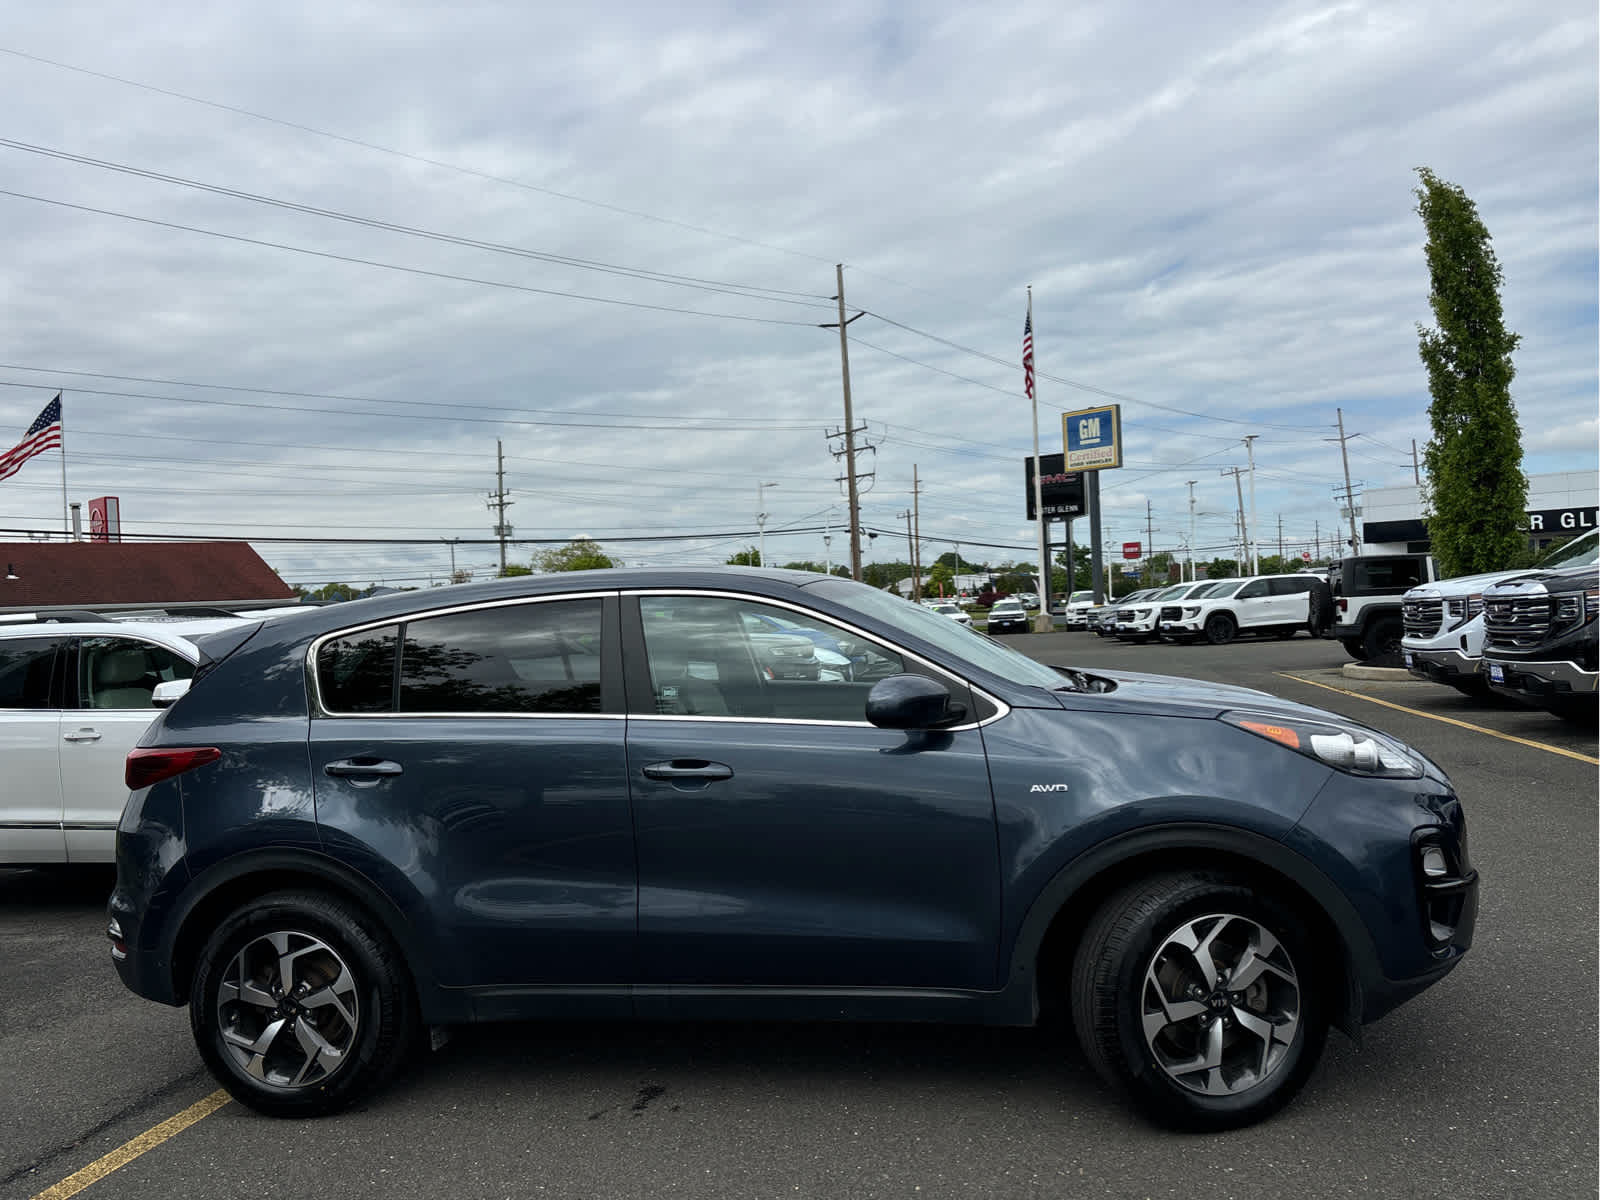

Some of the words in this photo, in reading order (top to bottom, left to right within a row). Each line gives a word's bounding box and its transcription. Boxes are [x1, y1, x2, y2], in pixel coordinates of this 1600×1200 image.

[1080, 418, 1100, 439] GM
[1069, 447, 1113, 463] Certified
[1033, 506, 1056, 515] LTER
[1057, 504, 1079, 513] GLENN
[1030, 784, 1068, 793] AWD
